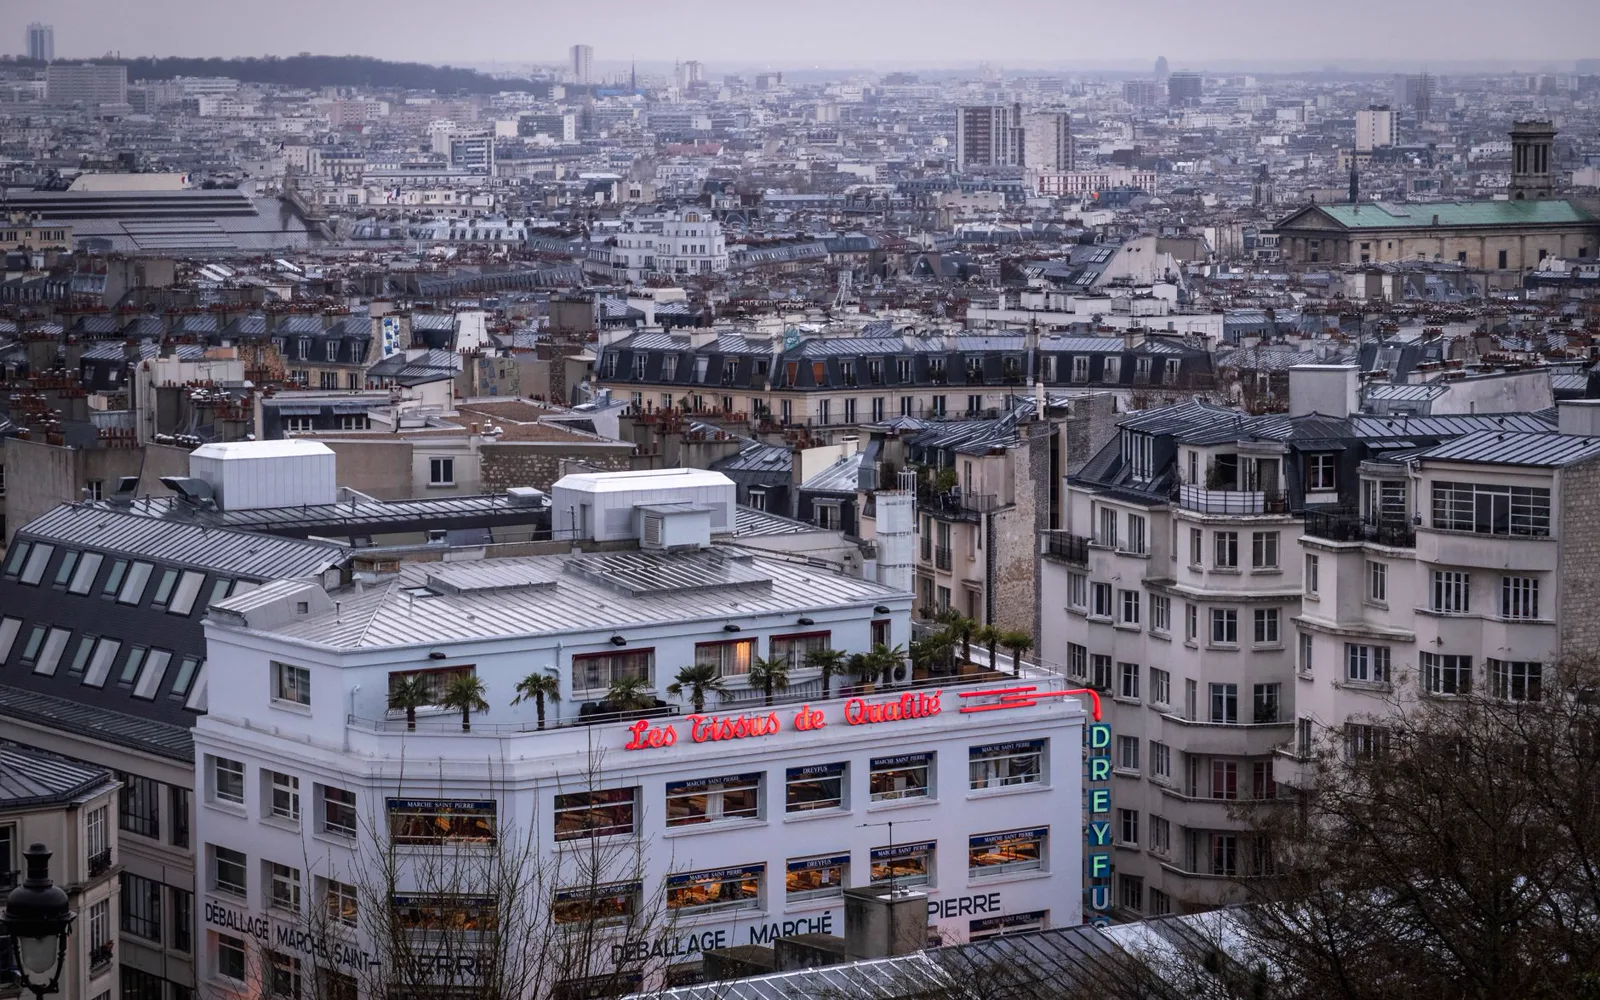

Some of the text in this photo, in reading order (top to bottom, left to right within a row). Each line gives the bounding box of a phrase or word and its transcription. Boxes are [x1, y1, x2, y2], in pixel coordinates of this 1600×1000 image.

[624, 690, 943, 750] Les Tissus de Qualité
[802, 765, 828, 773] DREYFUS
[806, 859, 832, 868] DREYFUS
[877, 848, 897, 857] MARHE
[205, 901, 269, 940] DÉBALLAGE
[611, 892, 1001, 965] DÉBALLAGE MARCHÉ PIERRE
